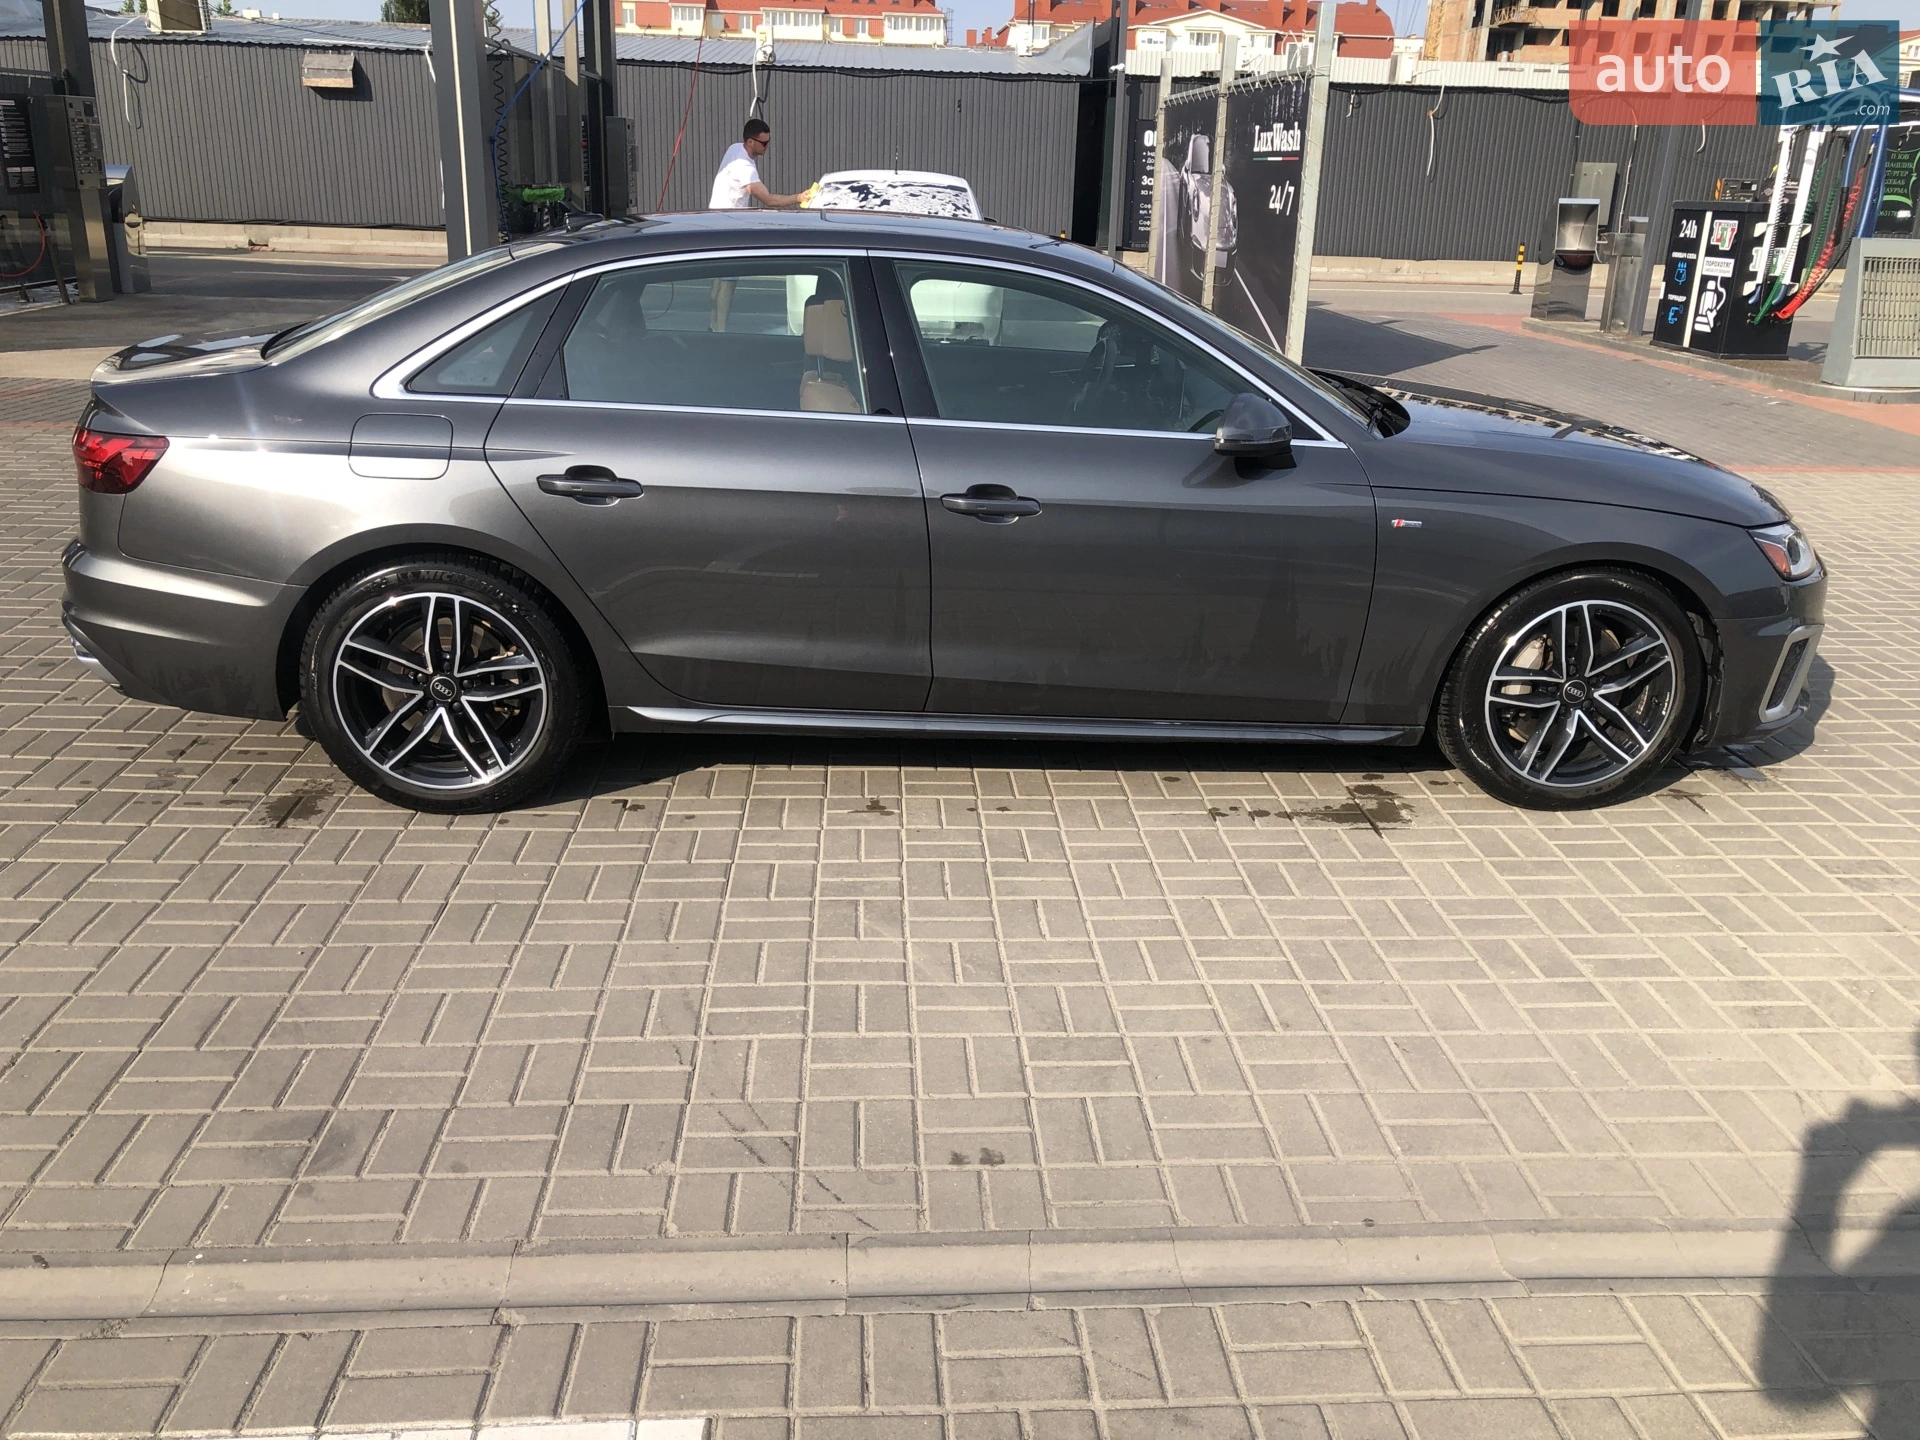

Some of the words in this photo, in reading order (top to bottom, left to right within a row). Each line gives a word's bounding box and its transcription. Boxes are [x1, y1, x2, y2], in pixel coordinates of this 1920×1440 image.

[1253, 121, 1301, 153] LuxWash
[1268, 180, 1295, 216] 24/7
[1679, 219, 1698, 239] 24h
